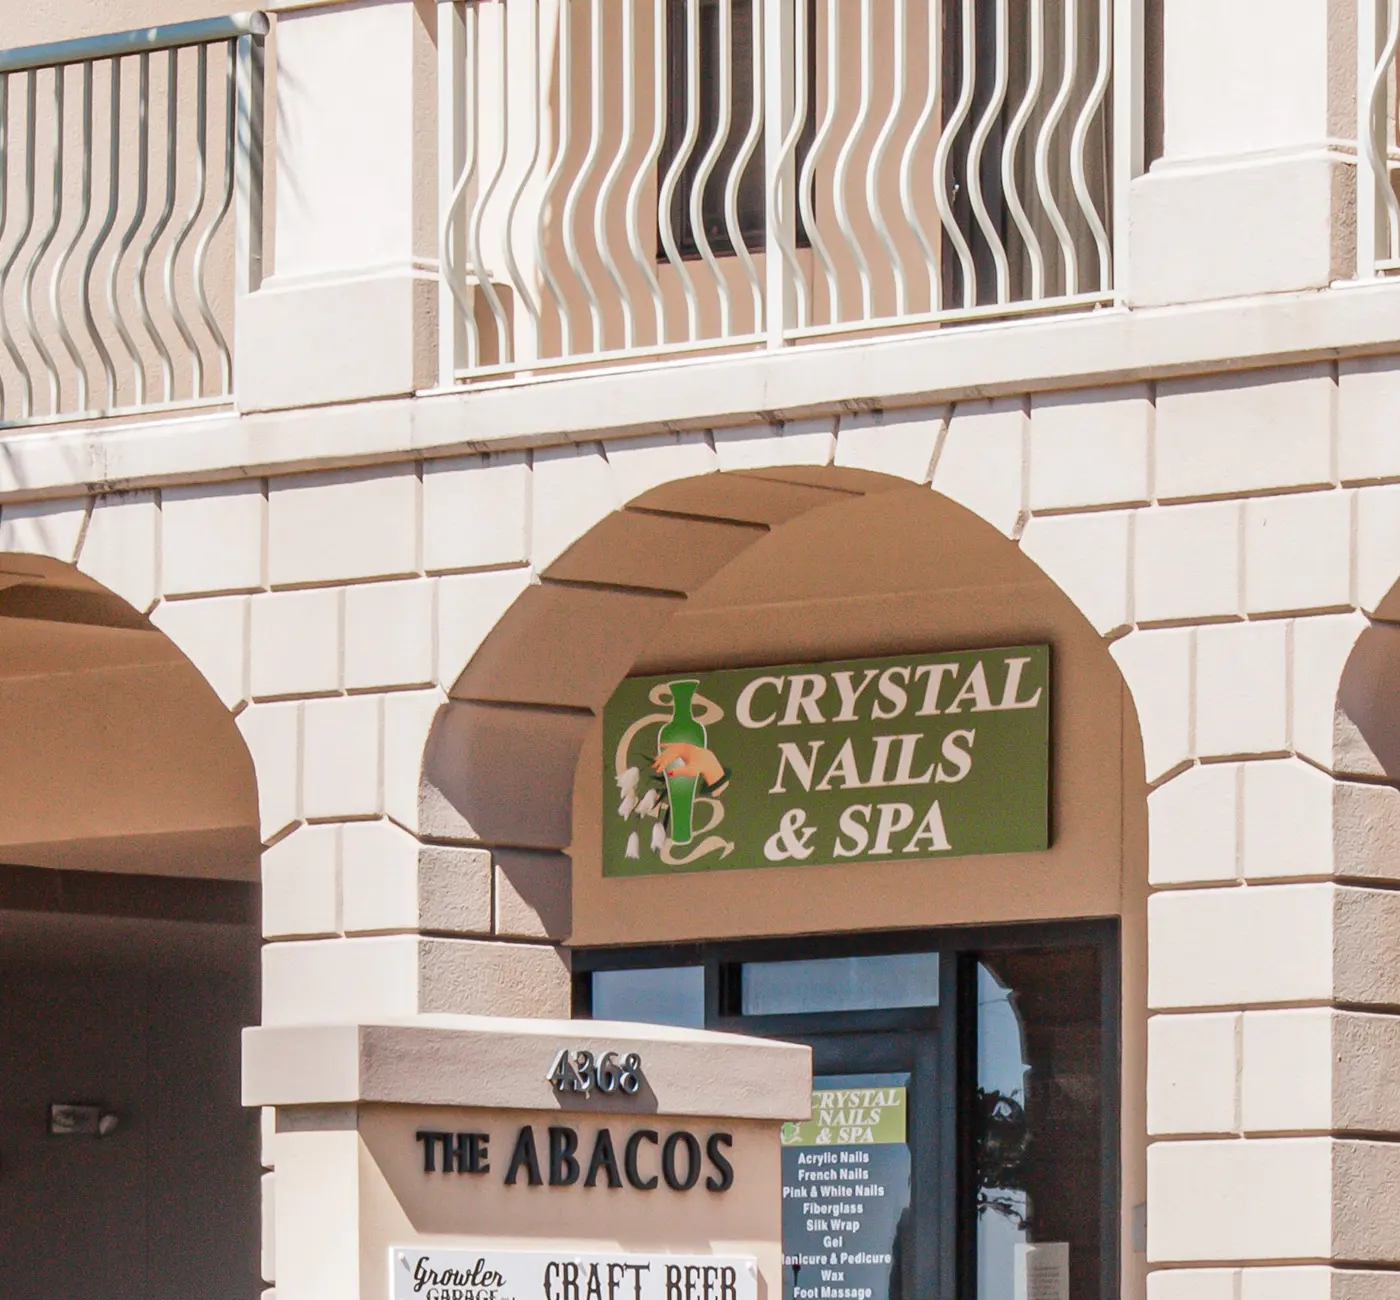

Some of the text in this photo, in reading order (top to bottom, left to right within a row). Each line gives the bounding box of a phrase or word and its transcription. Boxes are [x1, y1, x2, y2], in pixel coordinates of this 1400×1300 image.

[735, 656, 1043, 729] CRYSTAL
[768, 729, 976, 795] NAILS
[763, 800, 952, 861] & SPA
[546, 1047, 642, 1094] 4368
[818, 1108, 882, 1127] NAILS
[816, 1127, 874, 1144] & SPA
[416, 1125, 734, 1192] THE ABACOS
[798, 1151, 869, 1167] Acrylic Nails
[798, 1168, 869, 1181] French Nails
[783, 1184, 885, 1199] Pink & White Nails
[803, 1202, 864, 1217] Fiberglass
[806, 1219, 860, 1233] Silk Wrap
[823, 1235, 843, 1248] Gel
[829, 1252, 838, 1265] &
[840, 1252, 892, 1264] Pedicure
[413, 1256, 507, 1292] Growler
[821, 1269, 845, 1282] Wax
[793, 1286, 872, 1300] Foot Massage
